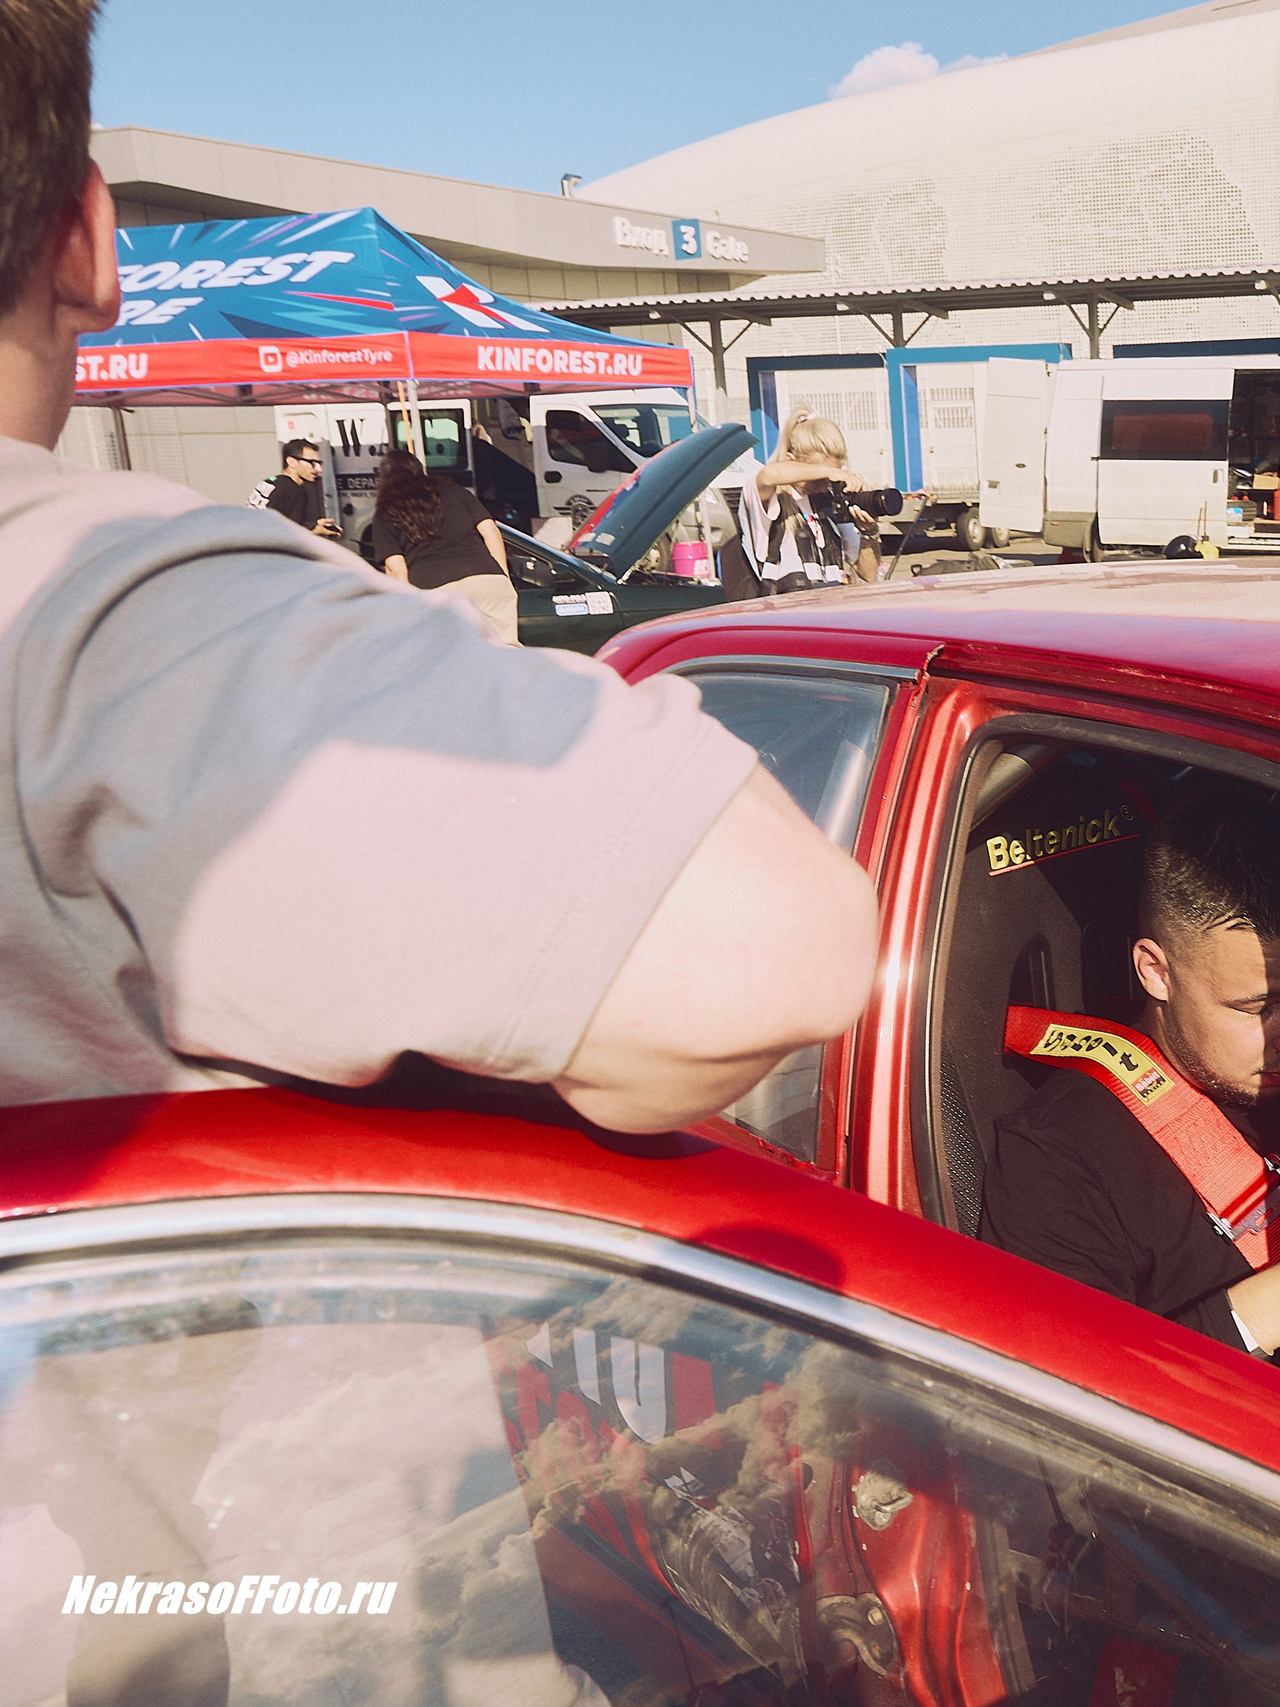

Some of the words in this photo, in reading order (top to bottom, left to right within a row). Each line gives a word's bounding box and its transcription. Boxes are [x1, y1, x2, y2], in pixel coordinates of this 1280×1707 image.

[680, 225, 698, 255] 3
[707, 230, 749, 262] Gate
[286, 348, 394, 368] @KinforestTyre
[477, 345, 643, 376] KINFOREST.RU
